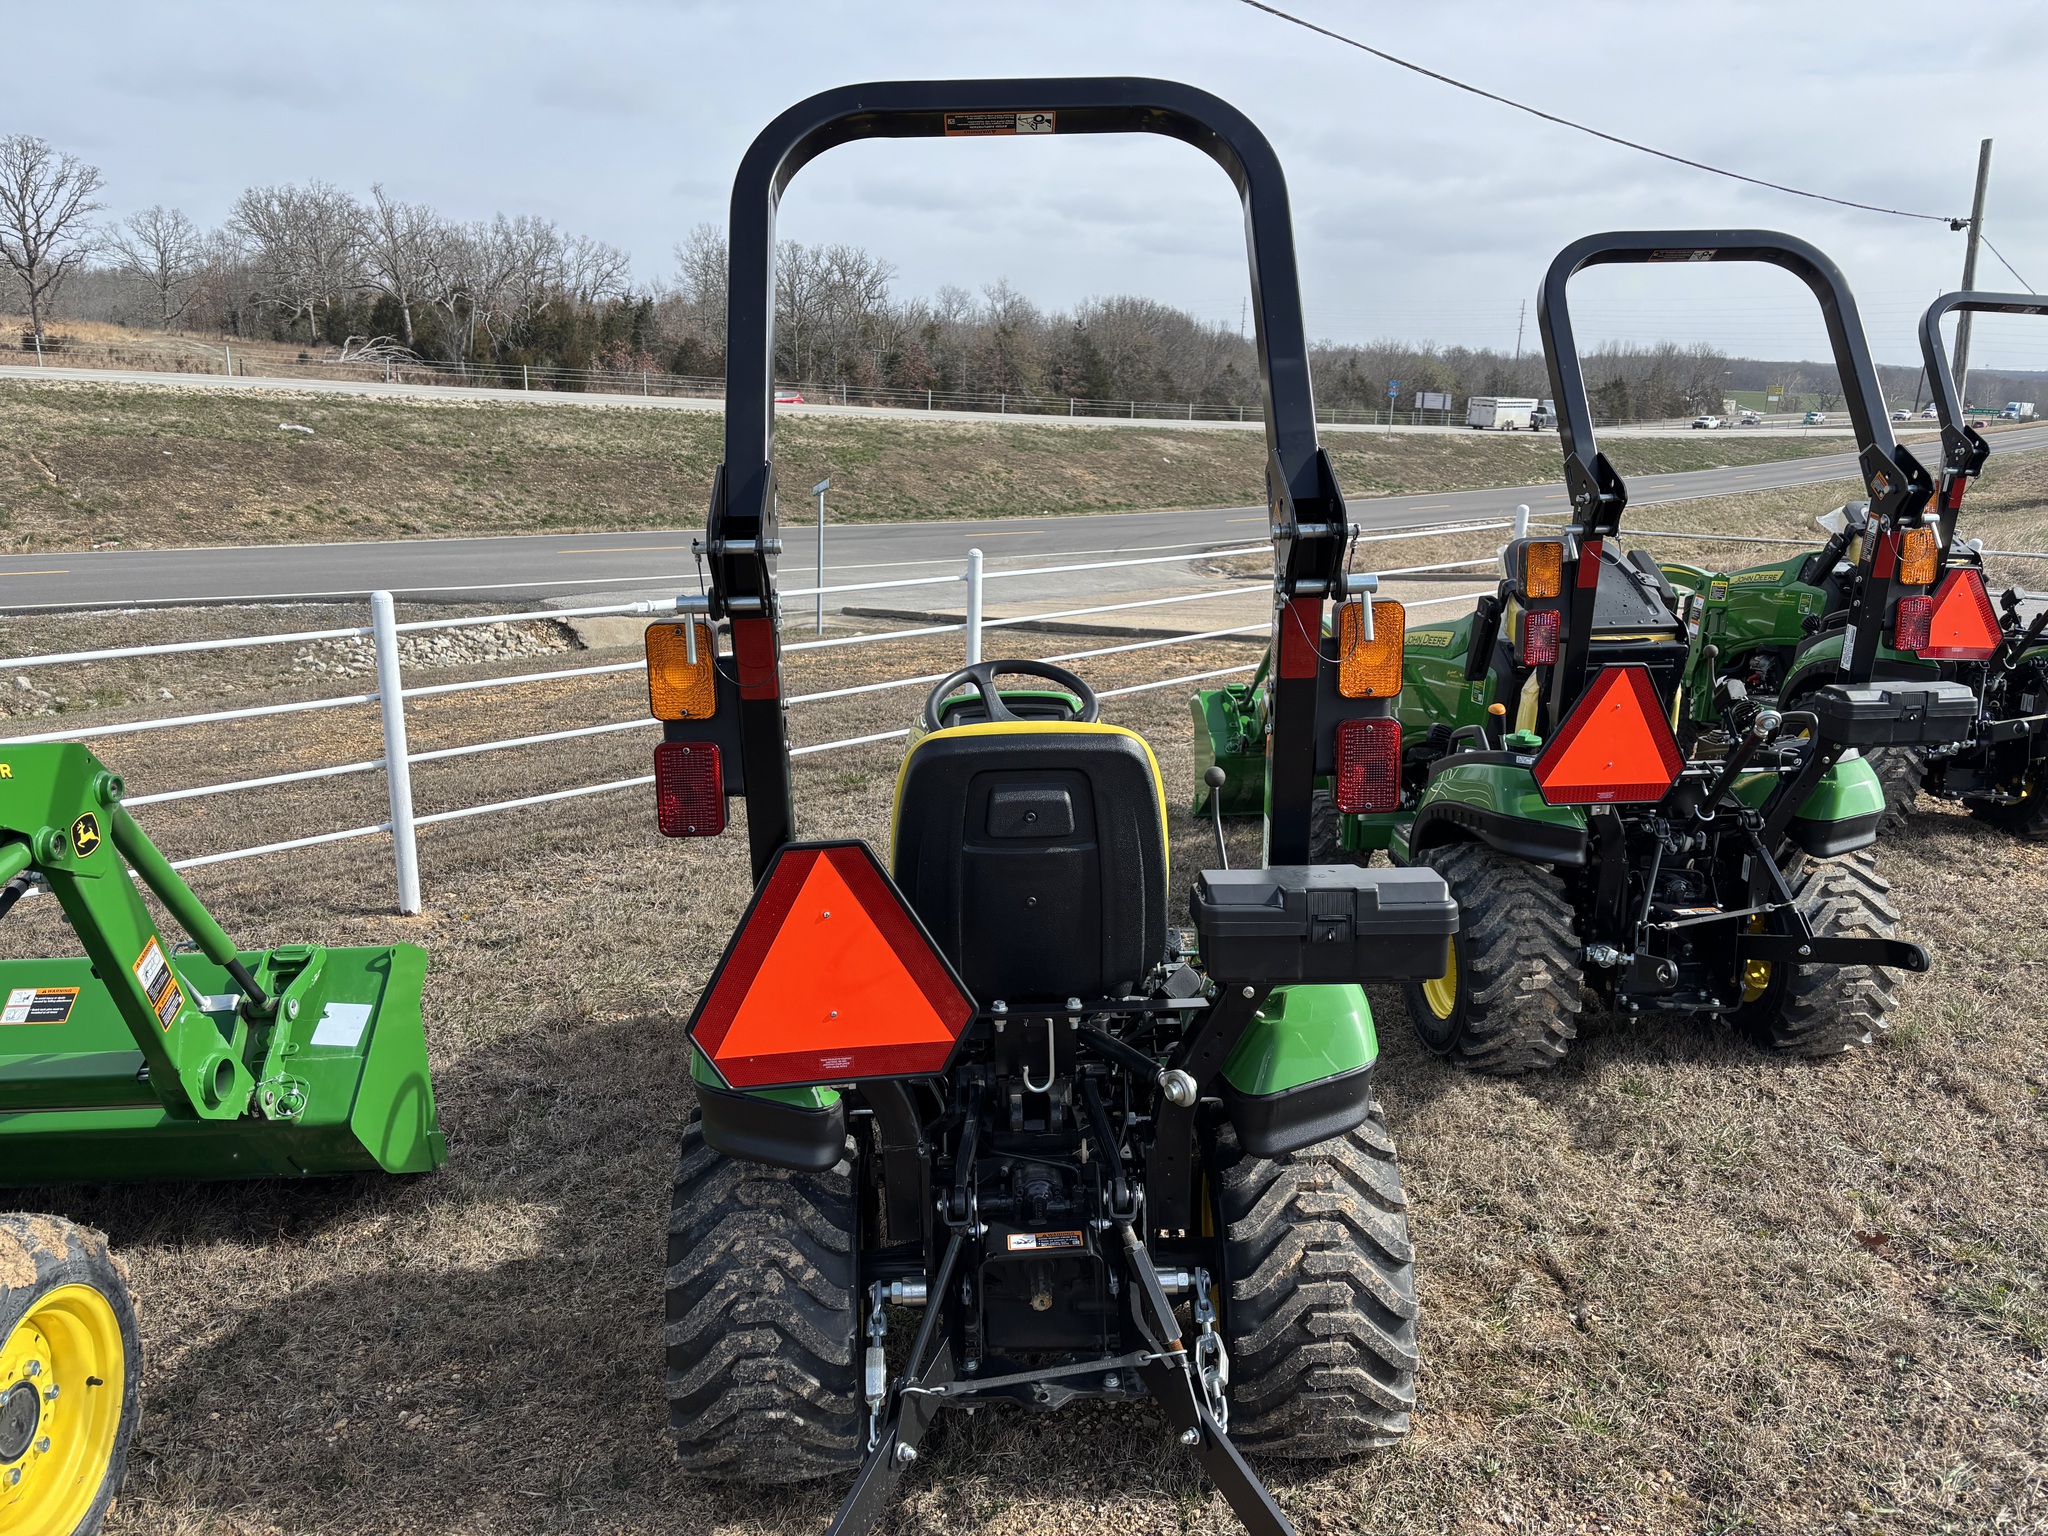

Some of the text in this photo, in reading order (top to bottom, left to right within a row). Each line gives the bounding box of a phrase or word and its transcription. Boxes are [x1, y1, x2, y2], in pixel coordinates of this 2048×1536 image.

[1735, 576, 1754, 584] JOHN
[1405, 634, 1447, 645] JOHN DEERE
